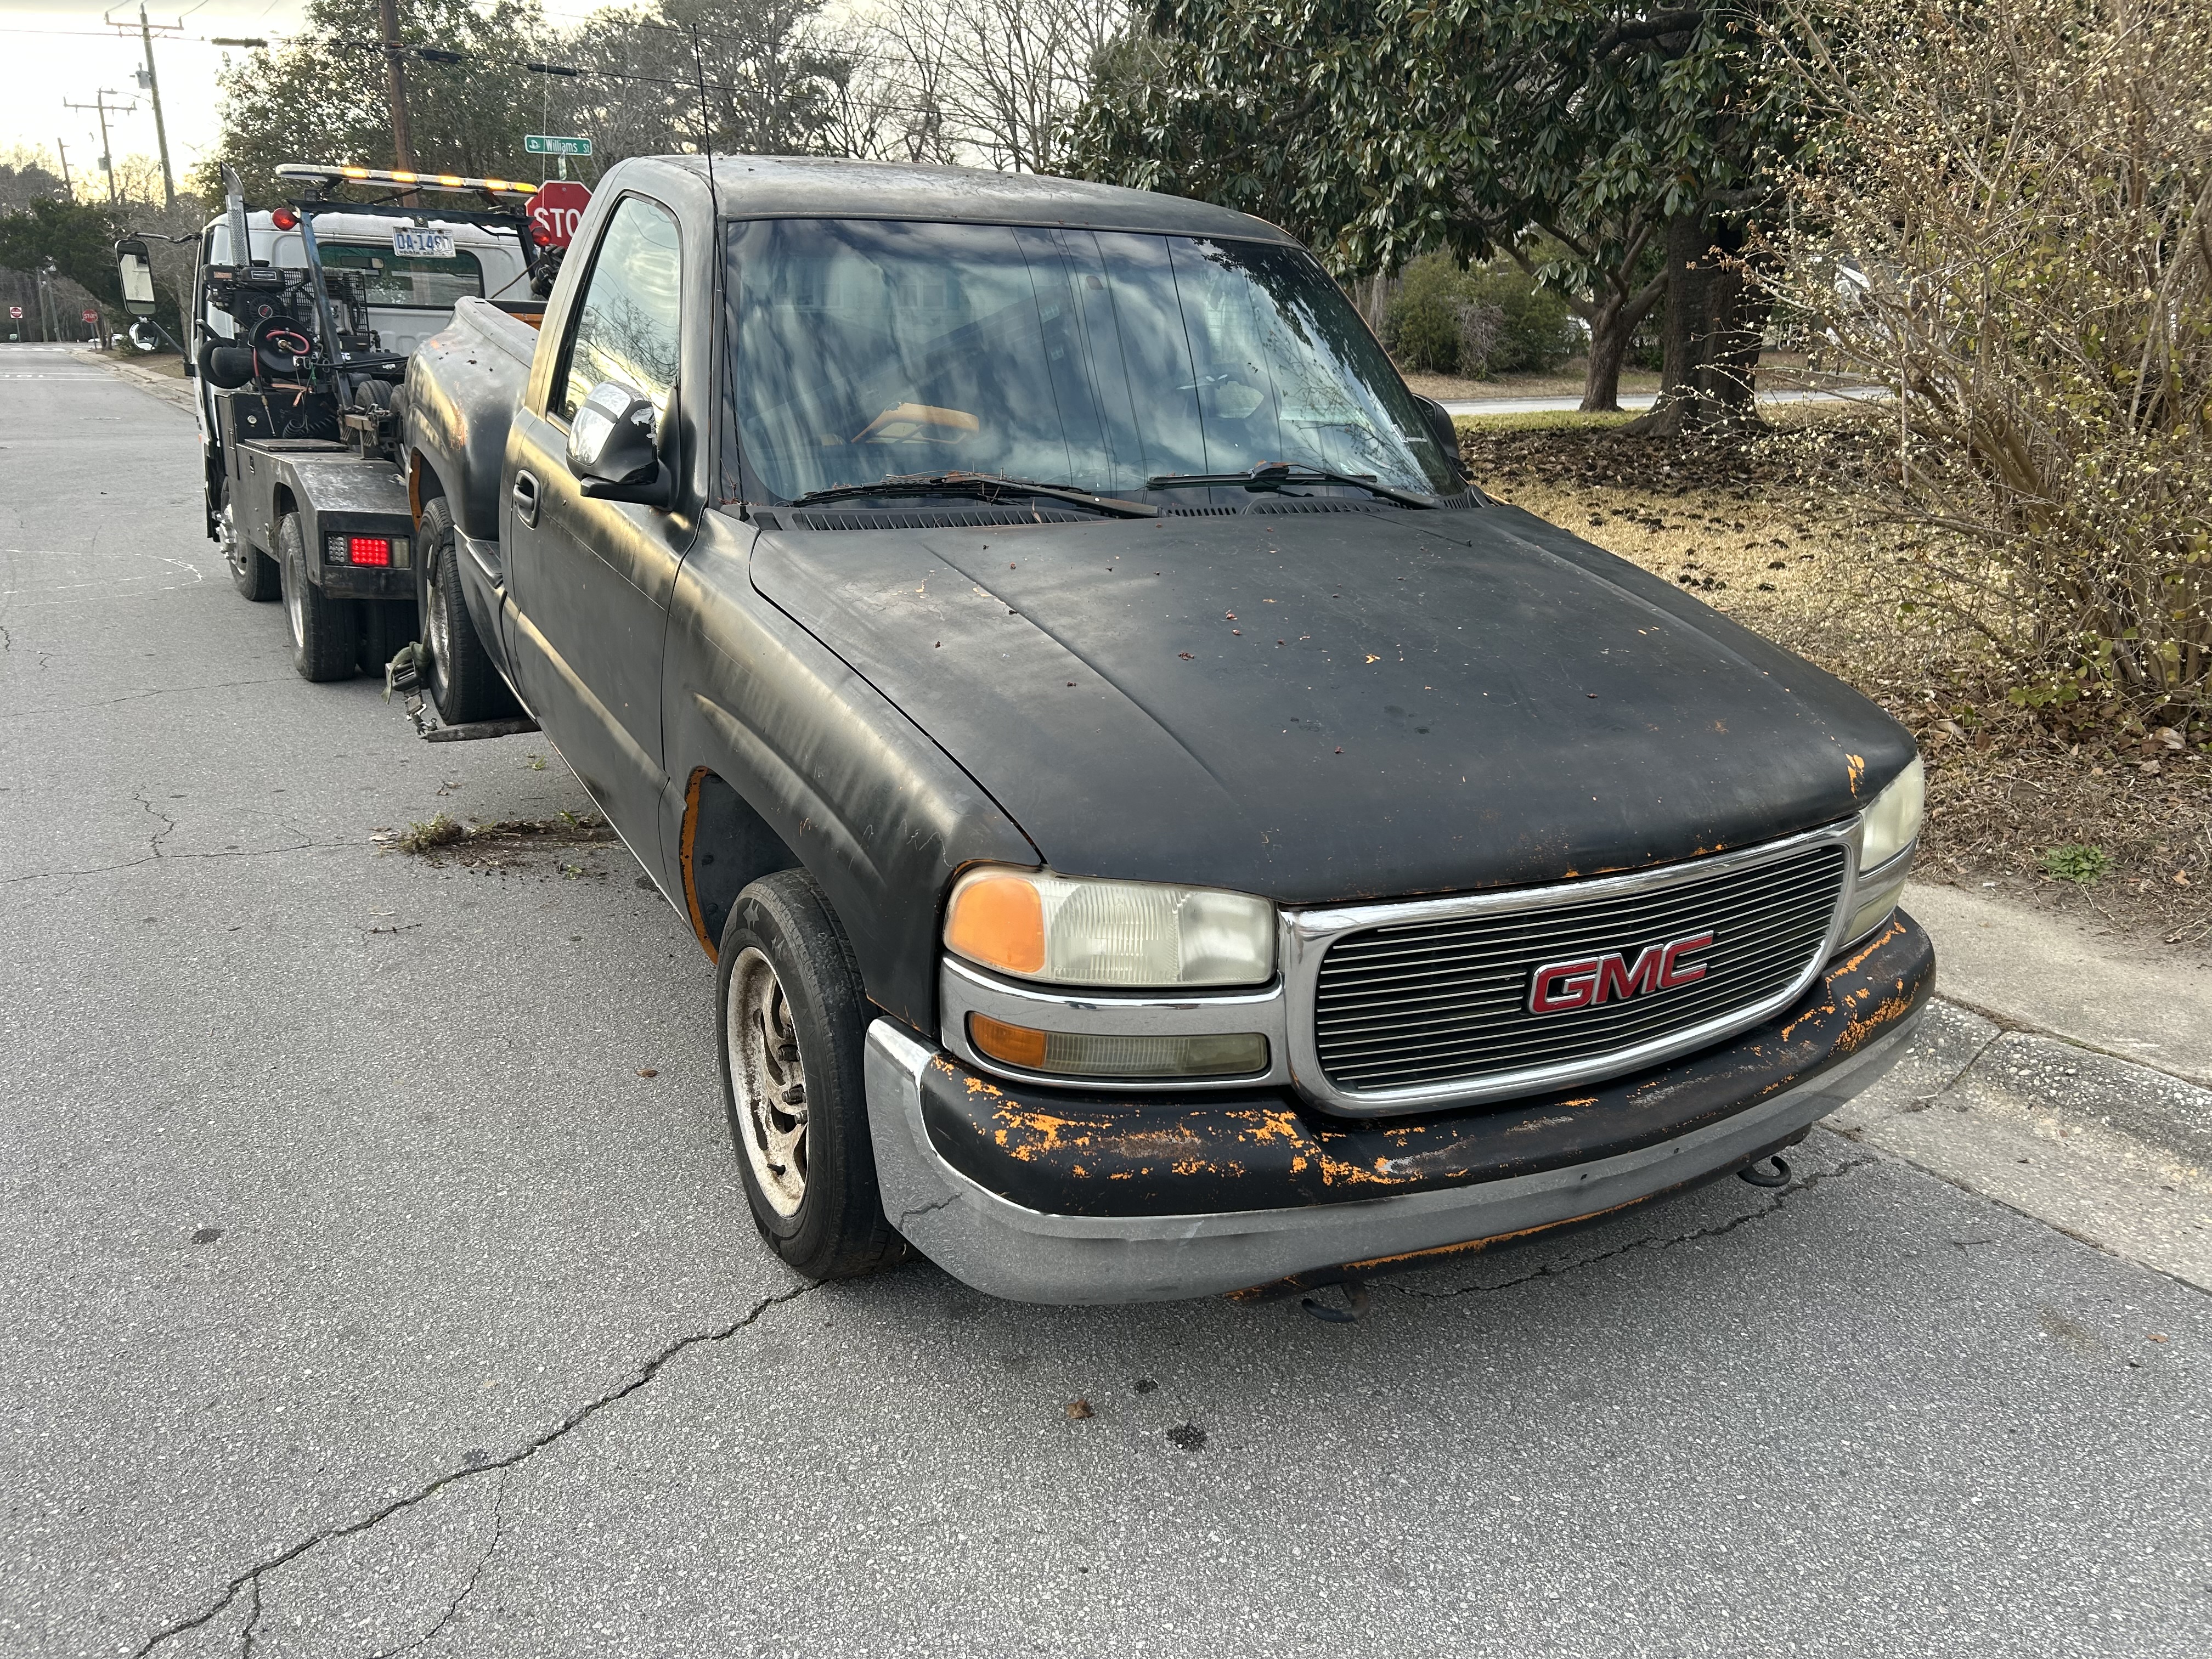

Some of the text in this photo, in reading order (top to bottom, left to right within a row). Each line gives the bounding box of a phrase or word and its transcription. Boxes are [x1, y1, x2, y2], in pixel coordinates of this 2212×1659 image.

[545, 139, 590, 153] Williams St
[534, 207, 583, 238] STO
[1528, 930, 1714, 1014] GMC
